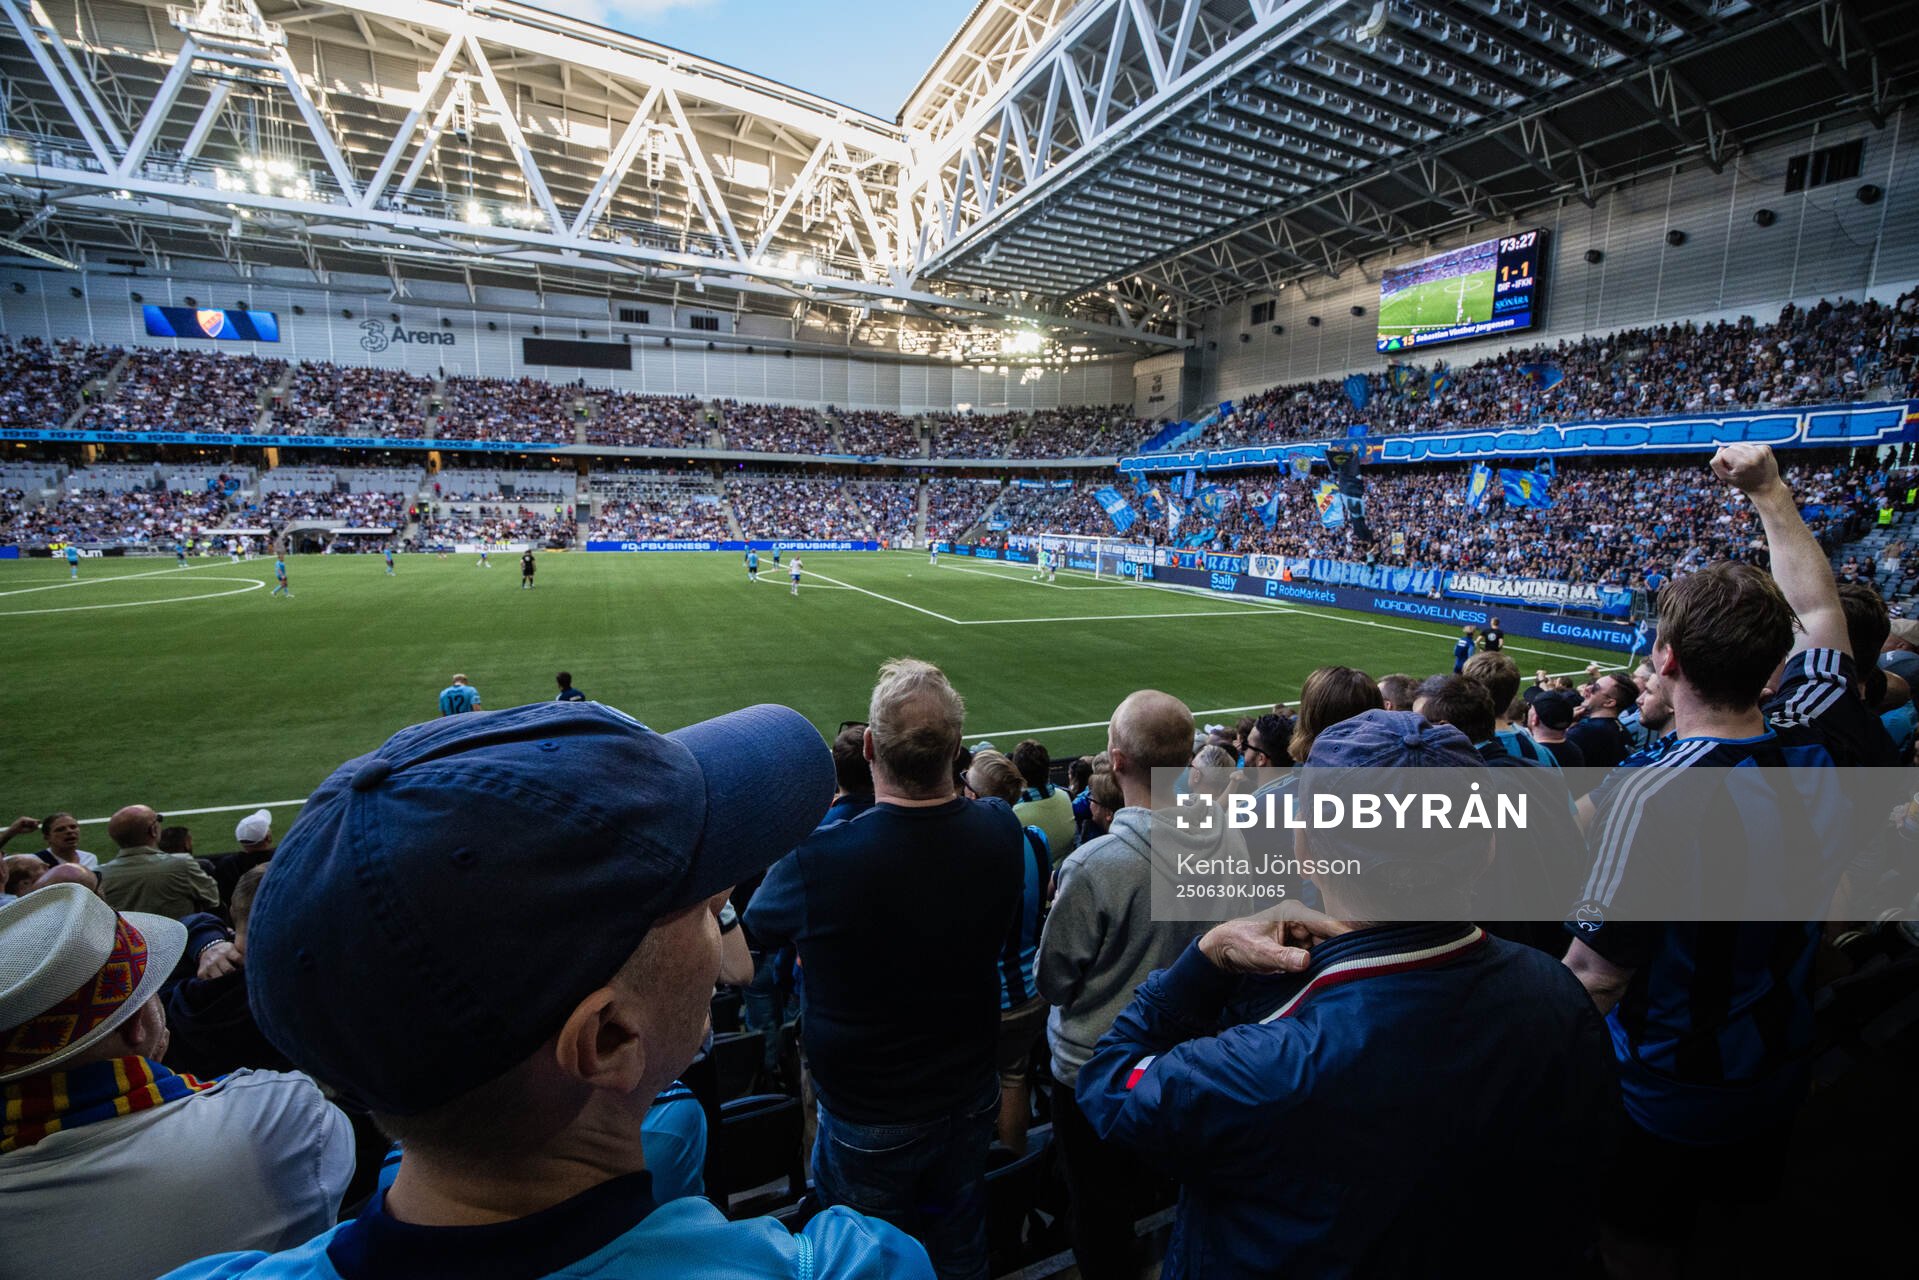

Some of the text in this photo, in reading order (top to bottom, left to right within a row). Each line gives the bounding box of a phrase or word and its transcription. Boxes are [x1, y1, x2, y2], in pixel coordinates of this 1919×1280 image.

[1500, 231, 1537, 254] 73:27
[1501, 265, 1509, 281] 1
[1521, 261, 1529, 277] 1
[391, 326, 456, 346] Arena
[1402, 335, 1415, 346] 15
[1382, 404, 1909, 461] DJURGÅRDENS IF
[1211, 572, 1237, 591] Saily
[1279, 584, 1336, 603] RoboMarkets
[1373, 598, 1488, 624] NORDICWELLNESS
[1541, 622, 1633, 645] ELGIGANTEN
[447, 694, 465, 715] 12
